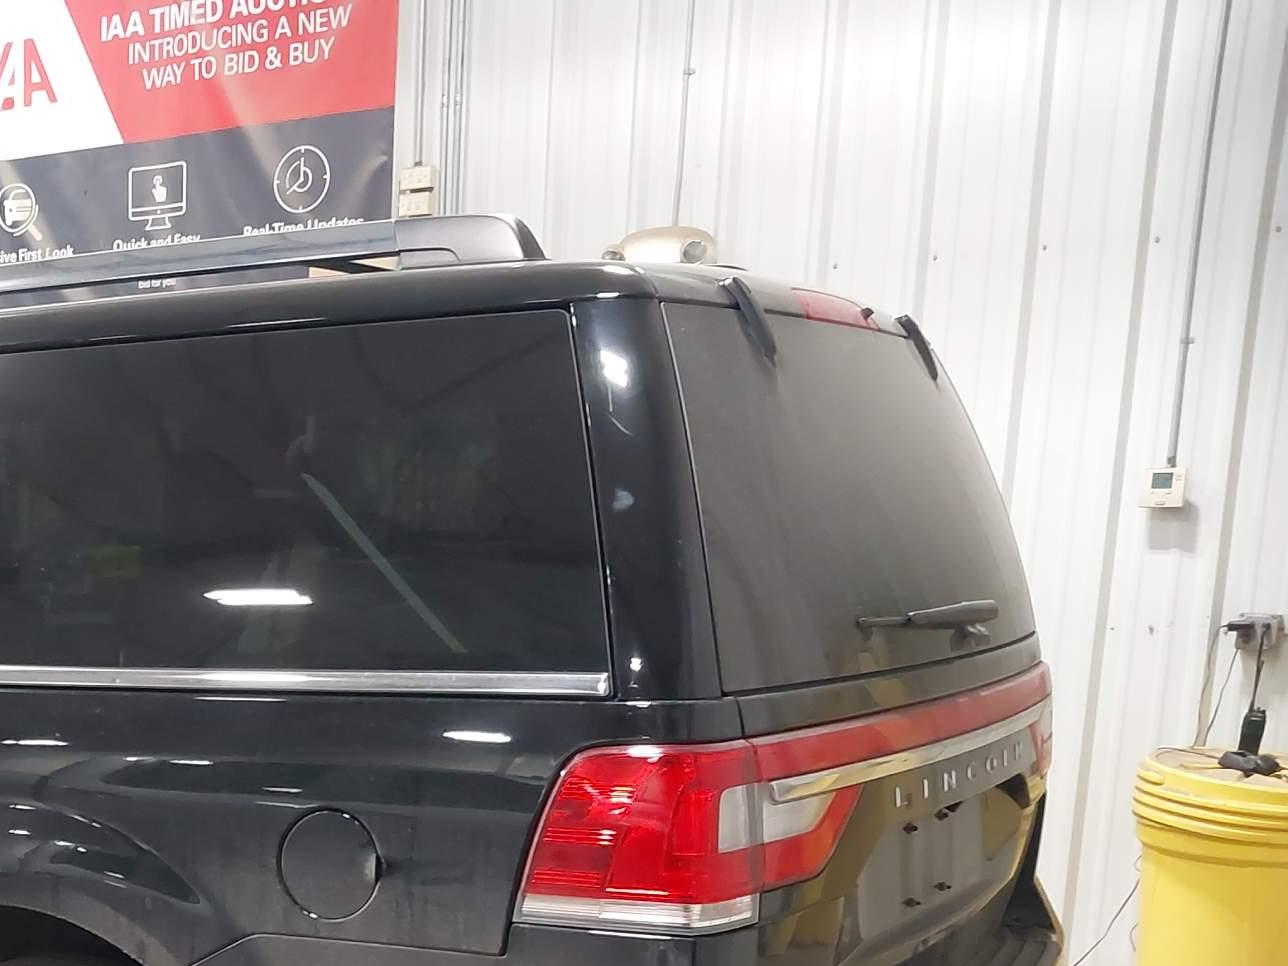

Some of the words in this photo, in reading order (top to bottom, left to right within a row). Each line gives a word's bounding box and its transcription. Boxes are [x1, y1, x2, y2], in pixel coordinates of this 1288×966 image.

[100, 11, 144, 42] IAA
[149, 0, 221, 34] TIMED
[128, 19, 268, 65] INTRODUCING
[274, 15, 292, 40] A
[298, 3, 352, 36] NEW
[142, 61, 186, 90] WAY
[190, 56, 216, 81] TO
[224, 50, 259, 76] BID
[264, 46, 282, 70] &
[288, 36, 335, 66] BUY
[18, 247, 42, 262] First
[112, 236, 148, 251] Quick
